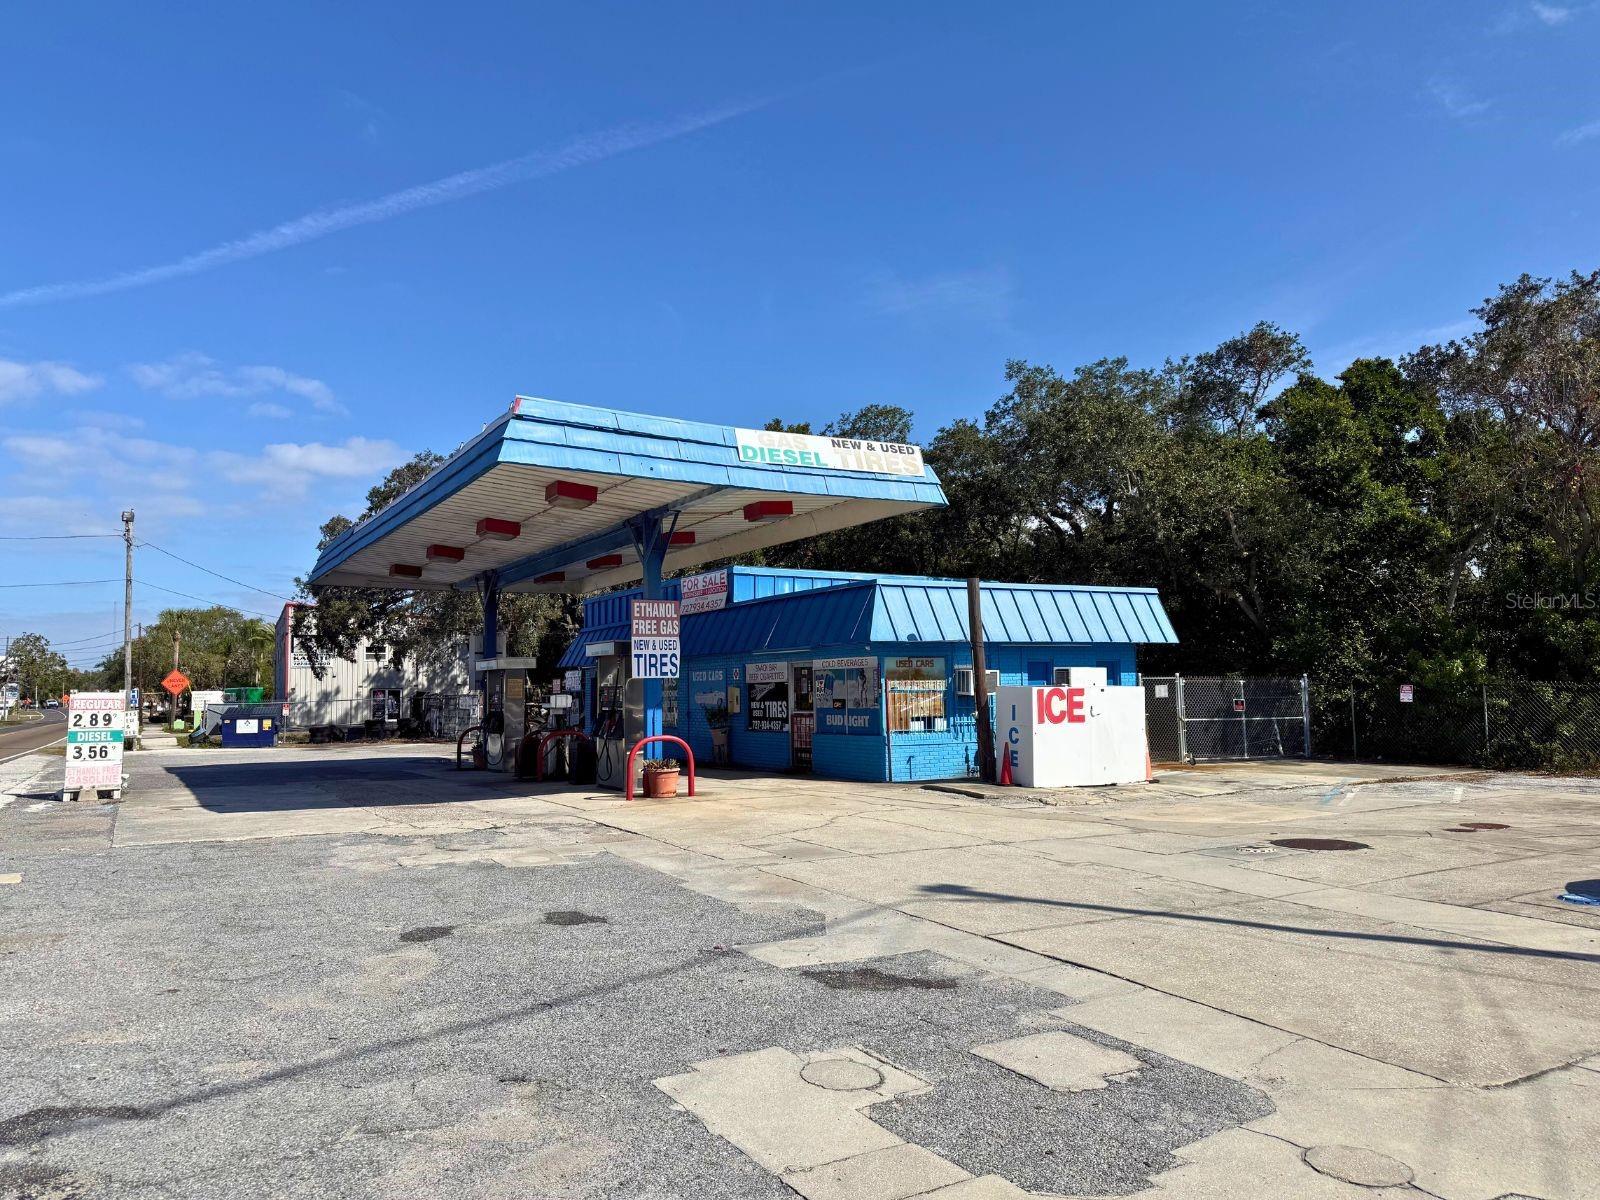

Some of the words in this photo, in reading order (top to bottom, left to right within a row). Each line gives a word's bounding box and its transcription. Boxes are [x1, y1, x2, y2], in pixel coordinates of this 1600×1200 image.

[757, 433, 808, 450] GAS
[831, 438, 862, 450] NEW
[866, 443, 877, 452] &
[879, 443, 915, 455] USED
[741, 445, 828, 467] DIESEL
[833, 449, 921, 475] TIRES
[682, 577, 699, 590] FOR
[702, 572, 726, 588] SALE
[634, 602, 677, 617] ETHANOL
[632, 620, 657, 635] FREE
[660, 620, 679, 635] GAS
[634, 639, 650, 651] NEW
[652, 640, 656, 651] &
[658, 639, 677, 651] USED
[633, 653, 678, 677] TIRES
[821, 660, 836, 668] COLD
[837, 659, 869, 667] BEVERAGES
[895, 660, 912, 668] USED
[915, 660, 935, 668] CARS
[692, 671, 707, 681] USED
[708, 670, 723, 681] CARS
[73, 700, 120, 710] REGULAR
[750, 701, 760, 709] NEW
[760, 701, 765, 709] &
[765, 701, 787, 718] TIRES
[1036, 688, 1086, 724] ICE
[73, 713, 112, 727] 2.89
[752, 709, 764, 717] USED
[826, 715, 843, 726] BUD
[77, 732, 113, 741] DIESEL
[1008, 704, 1020, 768] ICE
[72, 745, 108, 760] 3.56
[68, 775, 118, 785] GASOLINE
